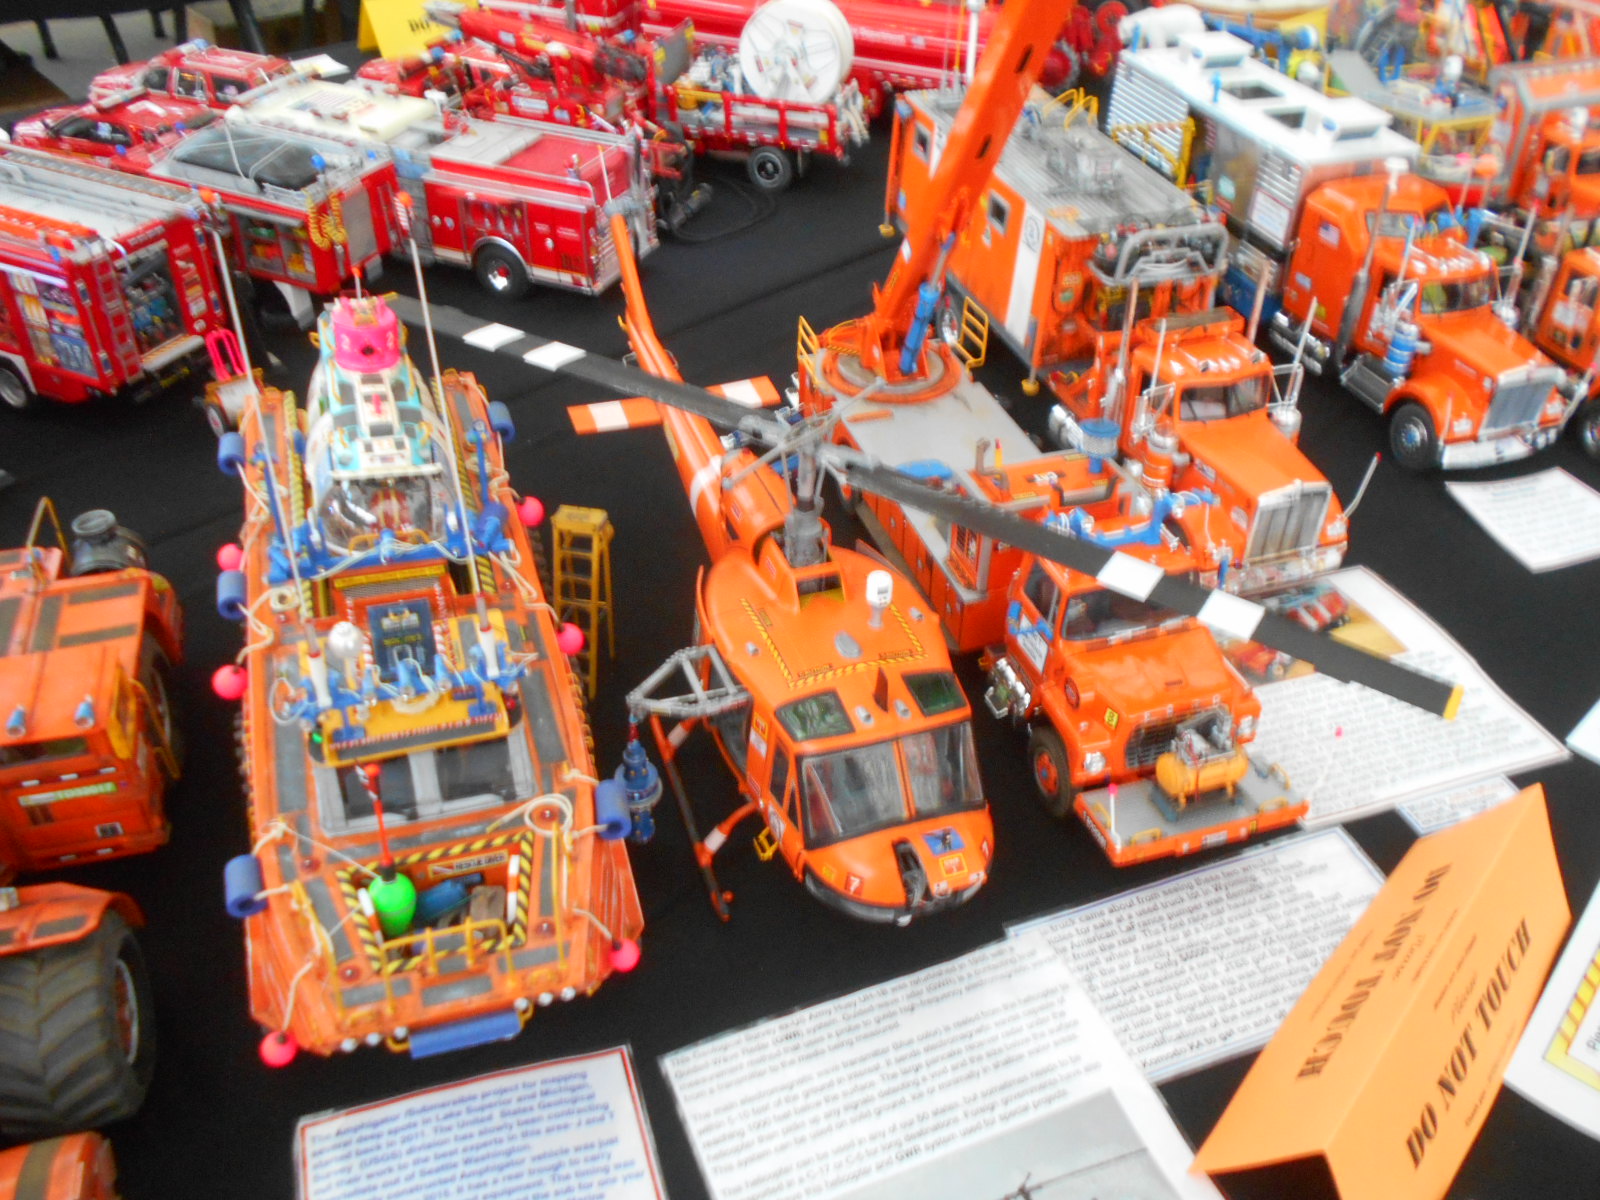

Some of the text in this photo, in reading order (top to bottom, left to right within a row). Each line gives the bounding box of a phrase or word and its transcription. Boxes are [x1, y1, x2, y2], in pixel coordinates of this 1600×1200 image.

[848, 876, 860, 892] 7
[1406, 1102, 1438, 1170] DO
[1438, 1024, 1477, 1111] NOT
[1476, 918, 1530, 1031] TOUCH
